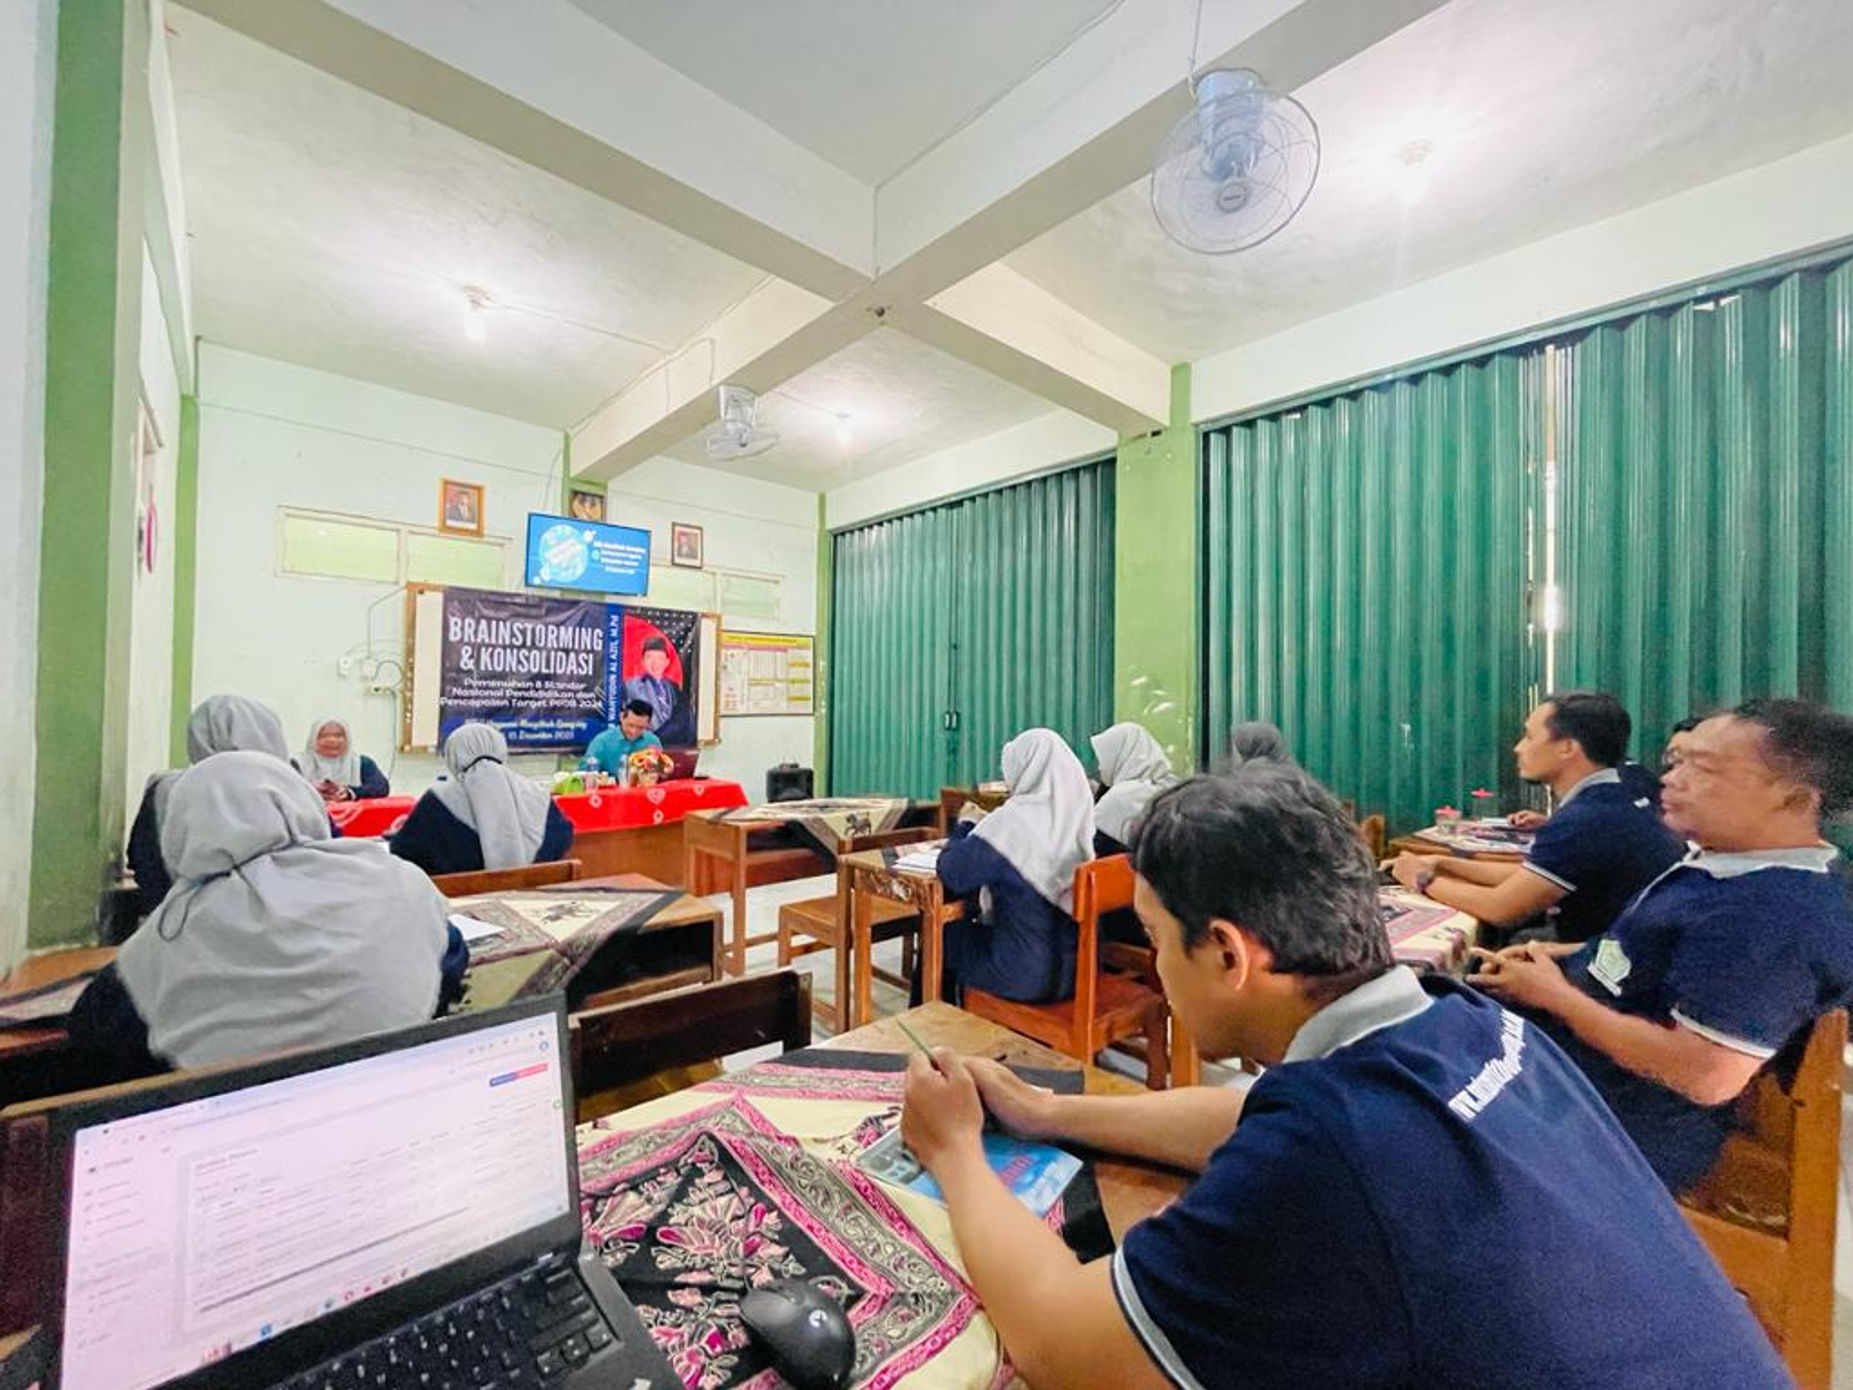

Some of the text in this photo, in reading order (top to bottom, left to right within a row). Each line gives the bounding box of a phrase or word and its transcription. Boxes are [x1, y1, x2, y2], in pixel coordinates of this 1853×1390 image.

[448, 616, 604, 651] BRAINSTORMING
[460, 645, 594, 676] & KONSOLIDASI
[452, 687, 504, 698] Nasional
[511, 698, 548, 709] Target
